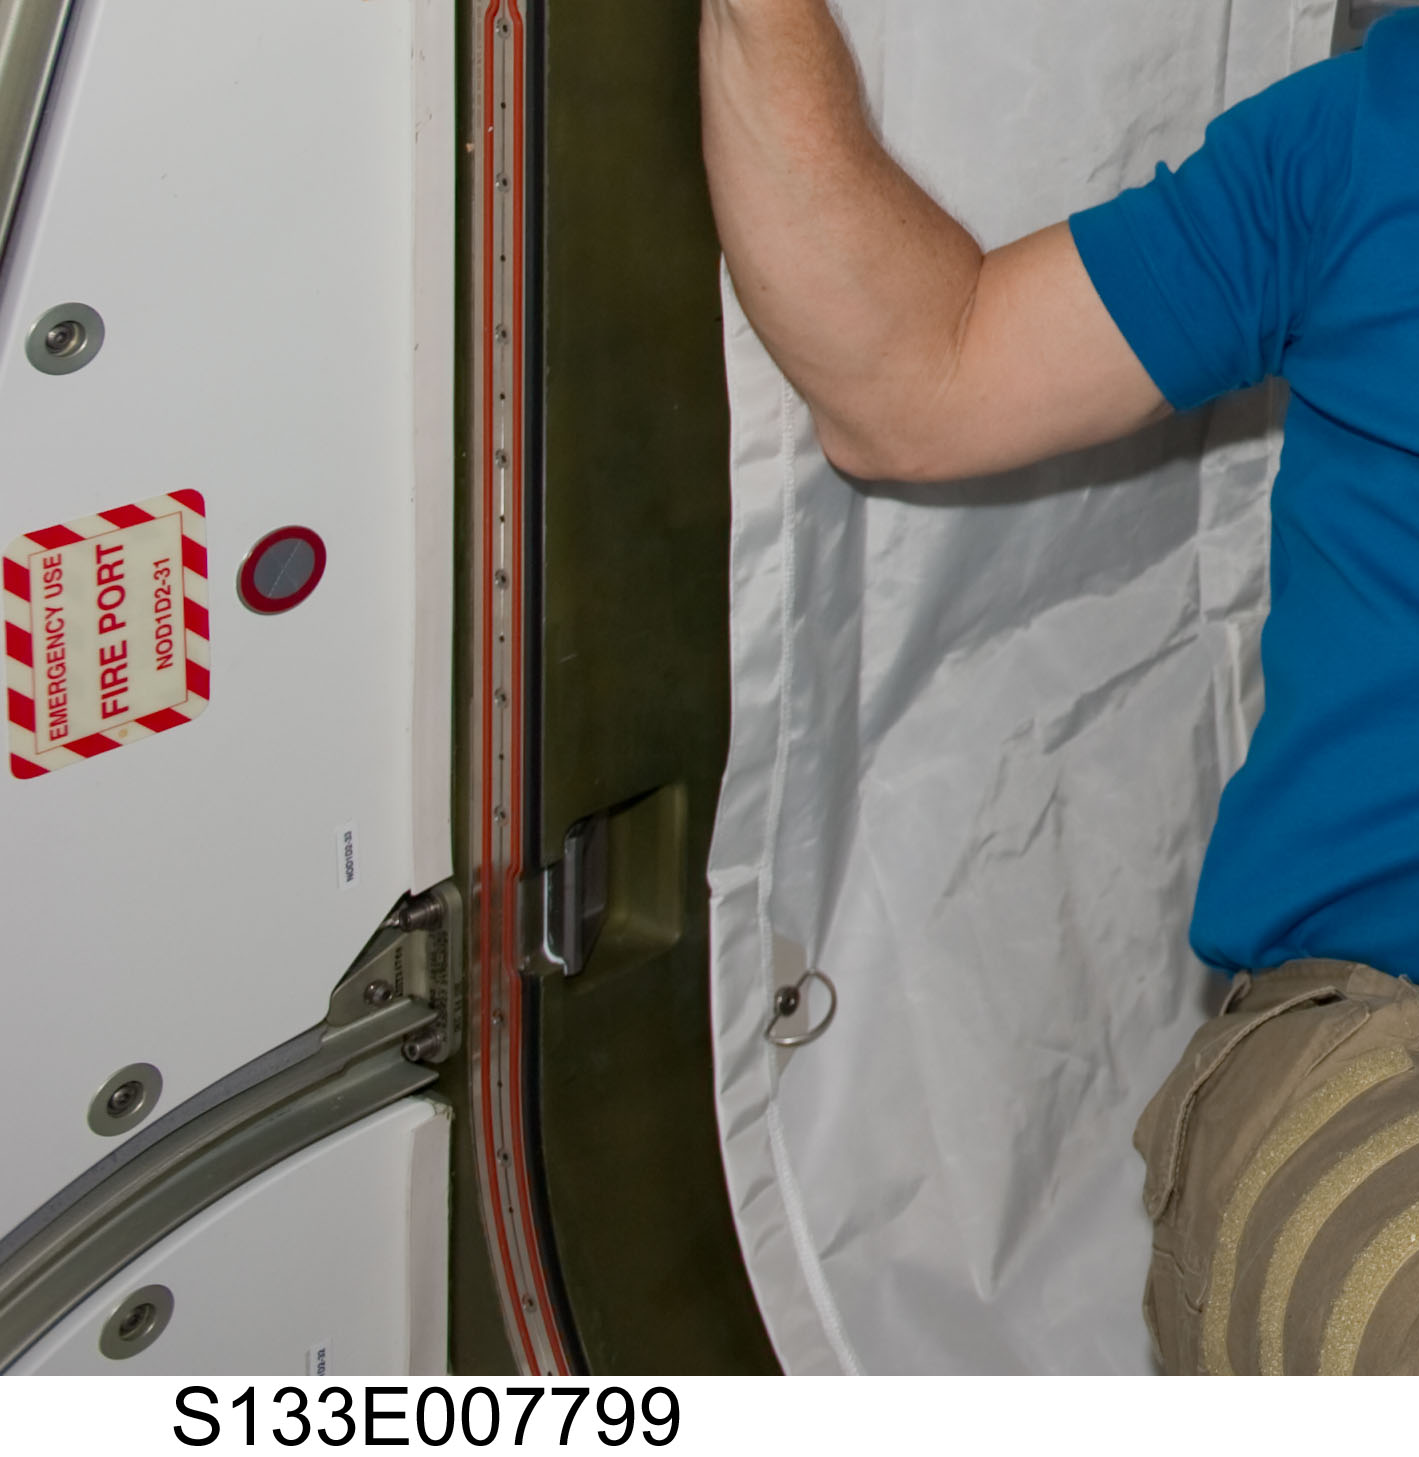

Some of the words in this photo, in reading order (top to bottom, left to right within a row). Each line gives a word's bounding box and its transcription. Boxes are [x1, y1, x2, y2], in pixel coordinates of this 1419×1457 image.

[43, 552, 64, 600] USE
[95, 544, 127, 635] PORT
[152, 556, 174, 671] NOD1D2-31
[44, 606, 69, 742] EMERGENCY
[98, 639, 130, 720] FIRE
